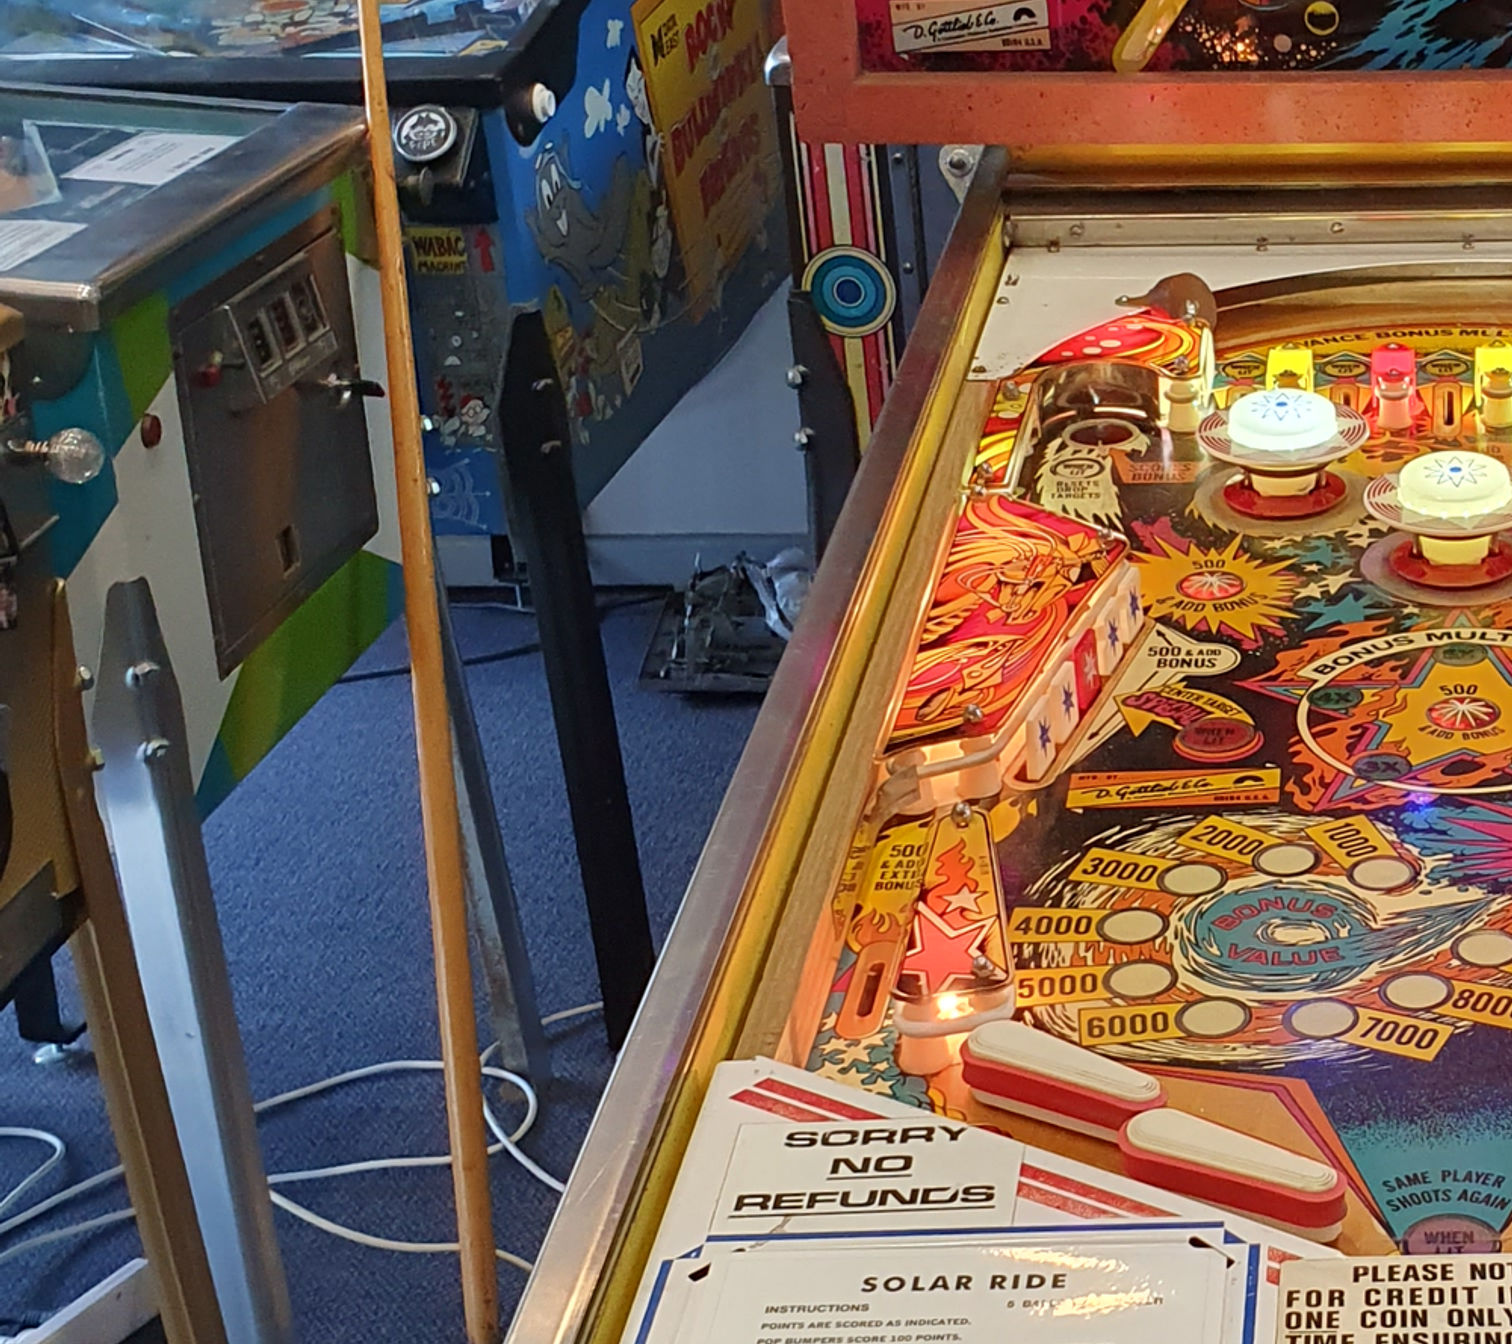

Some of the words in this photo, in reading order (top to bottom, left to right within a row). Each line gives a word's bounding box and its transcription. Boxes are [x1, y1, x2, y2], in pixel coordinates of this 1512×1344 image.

[1192, 559, 1226, 569] 500
[1147, 646, 1182, 657] 500
[1156, 657, 1218, 669] BONUS
[1311, 634, 1413, 677] BONUS
[1438, 683, 1479, 697] 500
[1198, 824, 1267, 857] 2000
[1321, 822, 1380, 858] 1000
[1080, 856, 1160, 884] 3000
[1209, 895, 1339, 932] BONUS
[1013, 914, 1093, 937] 4000
[1226, 942, 1342, 967] VALUE
[1017, 972, 1099, 999] 5000
[1086, 1011, 1170, 1039] 6000
[1358, 1015, 1440, 1051] 7000
[784, 1126, 968, 1149] SORRY
[829, 1155, 914, 1176] NO
[1382, 1170, 1432, 1193] SAME
[1440, 1169, 1506, 1190] PLAYER
[732, 1184, 996, 1213] REFUNDS
[1385, 1188, 1452, 1213] SHOOTS
[1457, 1189, 1511, 1212] AGAIN
[1423, 1230, 1475, 1244] WHEN
[861, 1274, 973, 1293] SOLAR
[989, 1273, 1068, 1291] RIDE
[1352, 1264, 1454, 1283] PLEASE
[764, 1304, 870, 1314] INSTRUCTIONS
[1285, 1289, 1345, 1308] FOR
[1364, 1287, 1479, 1307] CREDIT
[761, 1322, 805, 1330] POINTS
[807, 1321, 832, 1329] ARE
[835, 1320, 884, 1328] SCORED
[886, 1319, 901, 1327] AS
[905, 1317, 971, 1326] INDICATED.
[1284, 1310, 1341, 1330] ONE
[1360, 1309, 1428, 1329] COIN
[785, 1337, 844, 1344] BUMPERS
[847, 1335, 887, 1344] SCORE
[890, 1334, 912, 1342] 100
